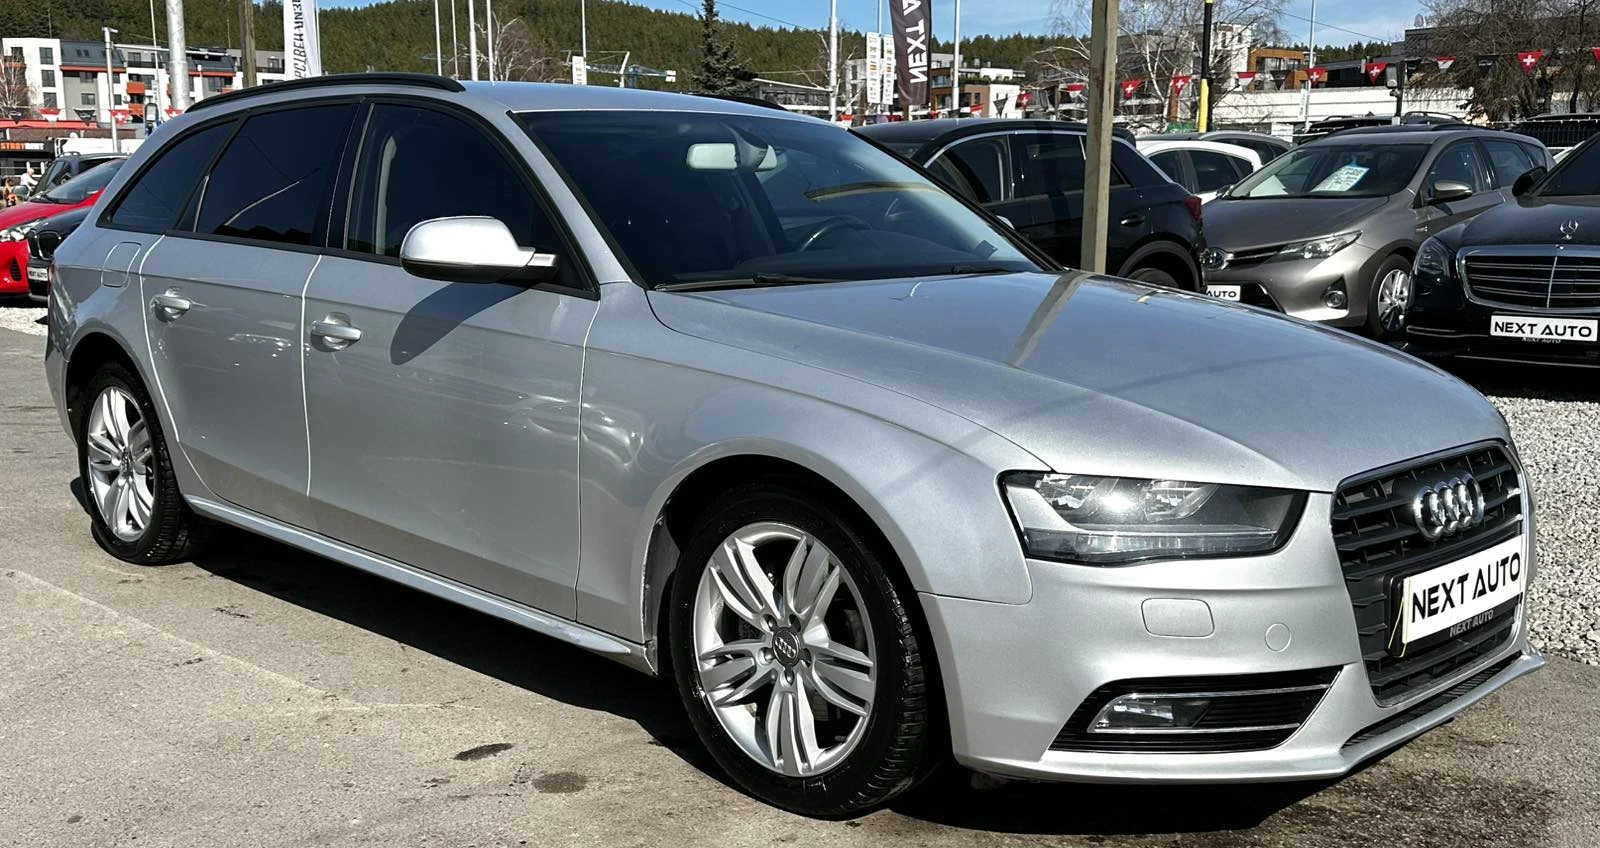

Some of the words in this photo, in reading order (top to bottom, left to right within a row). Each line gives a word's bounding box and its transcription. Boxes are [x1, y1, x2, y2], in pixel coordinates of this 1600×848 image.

[1206, 290, 1237, 298] AUTO
[1494, 321, 1538, 335] NEXT
[1540, 324, 1592, 337] AUTO
[1412, 573, 1469, 623] NEXT
[1472, 552, 1521, 600] AUTO
[1449, 619, 1472, 637] NEXT
[1472, 609, 1494, 627] AUTO
